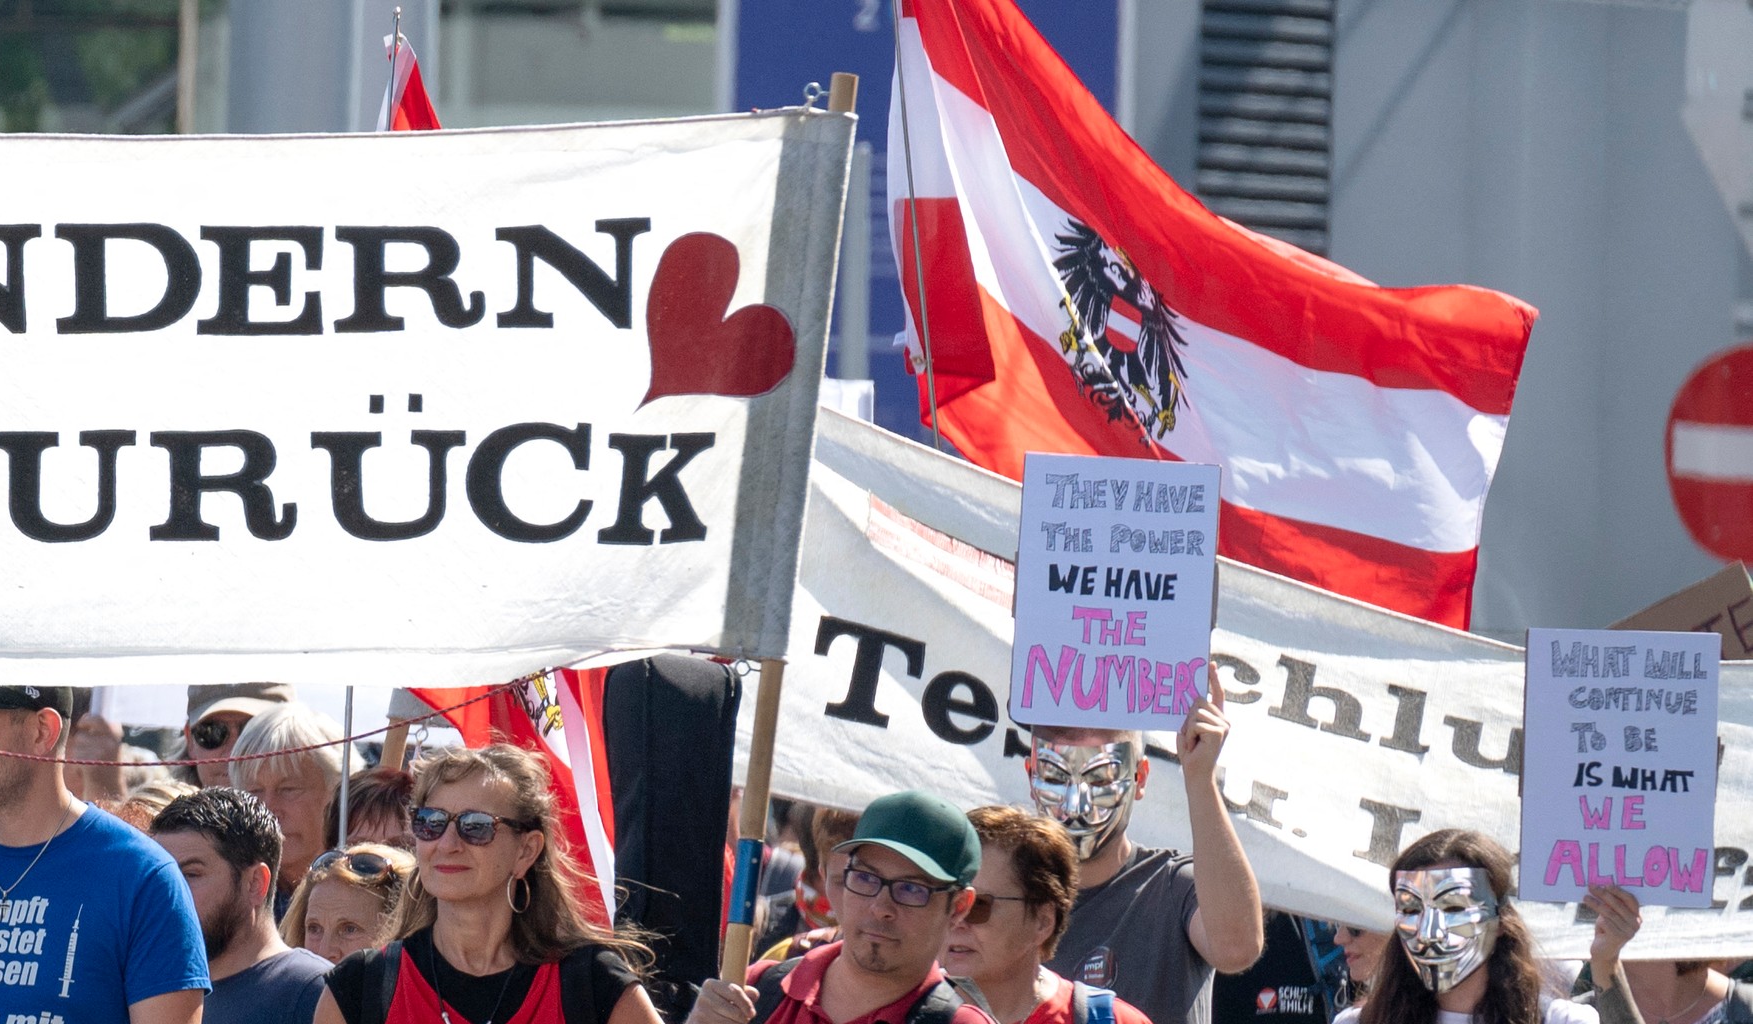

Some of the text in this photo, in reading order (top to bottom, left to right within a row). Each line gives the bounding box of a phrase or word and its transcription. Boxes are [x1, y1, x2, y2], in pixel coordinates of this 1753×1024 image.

[1045, 473, 1205, 513] THEY HAVE
[1041, 521, 1204, 556] THE POWER
[1048, 563, 1178, 601] WE HAVE
[1071, 605, 1147, 646] THE
[1551, 640, 1708, 680] WHAT WILL
[1568, 686, 1698, 715] CONTINUE
[1570, 722, 1658, 753] TO BE
[1573, 761, 1694, 793] IS WHAT
[1579, 795, 1646, 830] WE
[1543, 839, 1709, 893] ALLOW
